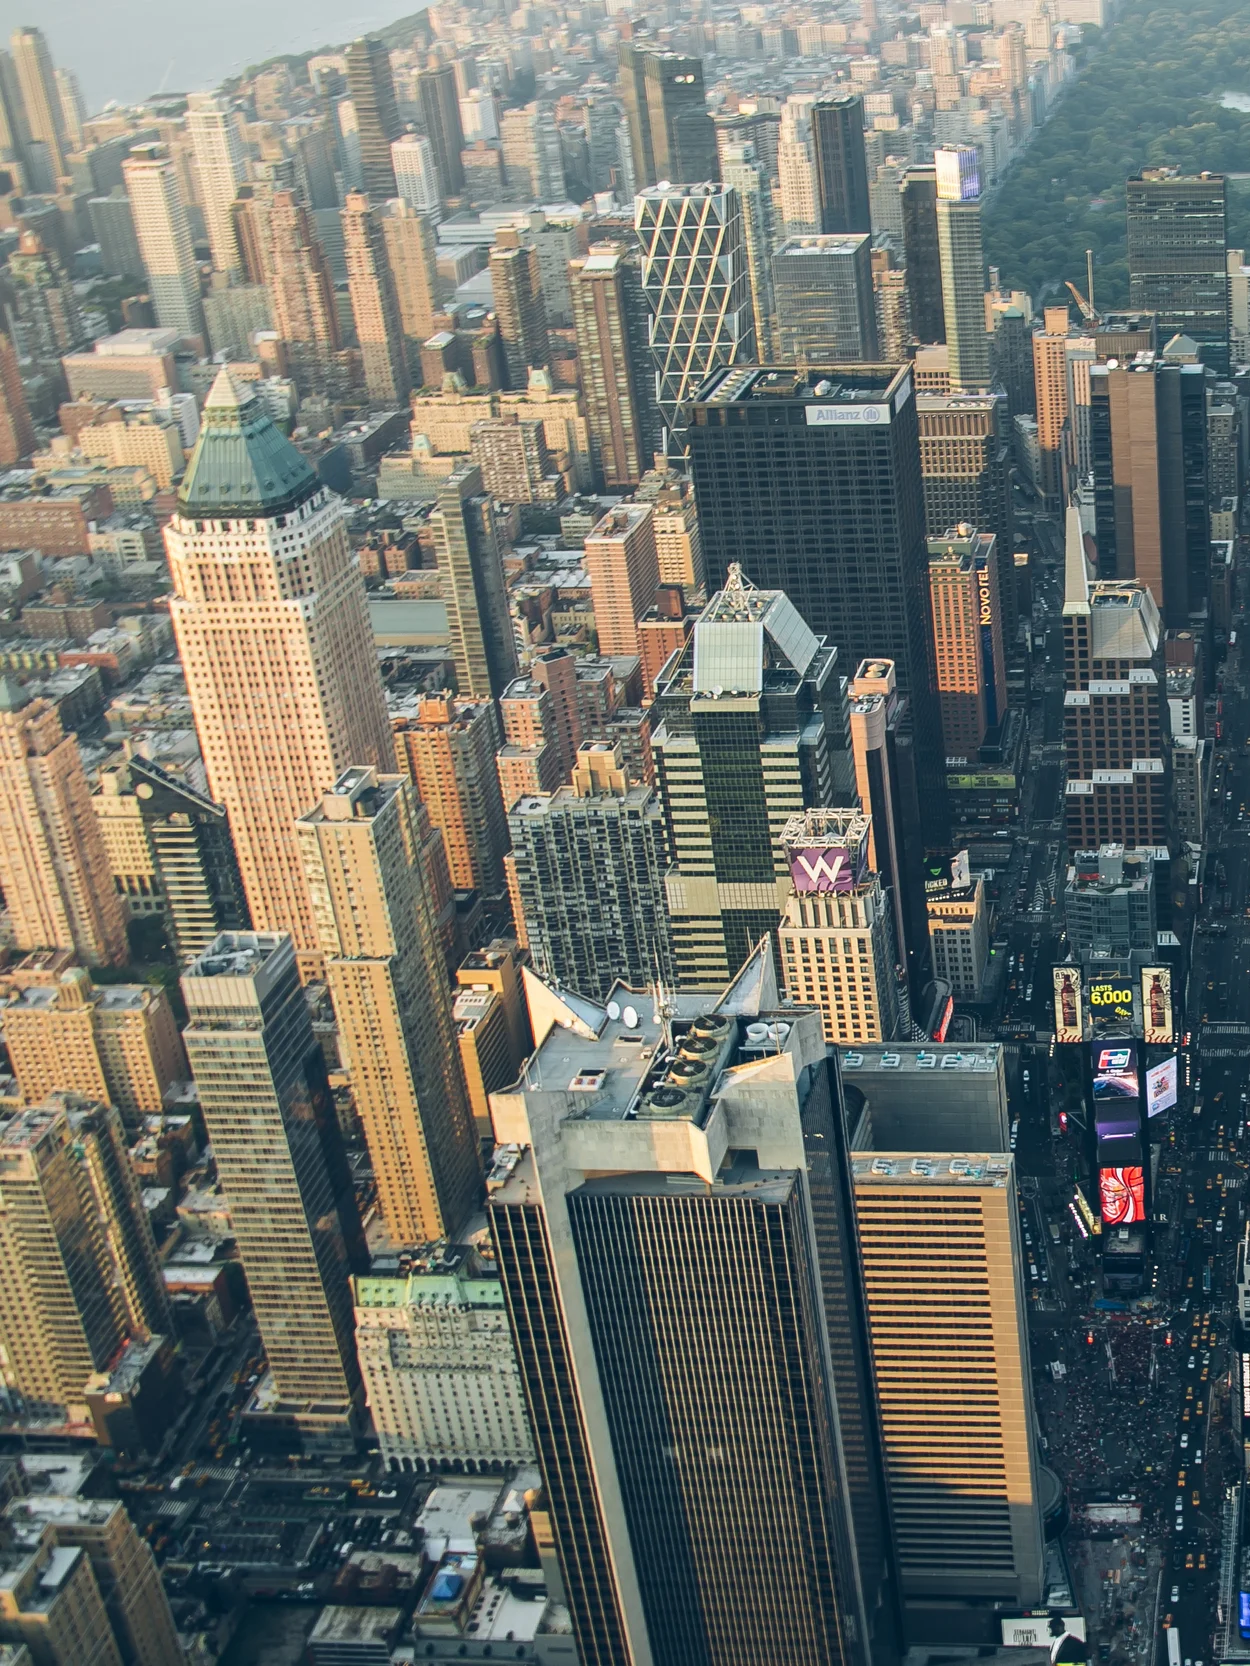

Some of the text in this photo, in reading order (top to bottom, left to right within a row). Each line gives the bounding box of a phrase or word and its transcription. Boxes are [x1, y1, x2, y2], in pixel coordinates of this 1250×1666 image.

[816, 409, 861, 421] Allianz
[976, 565, 992, 625] NOVOTEL
[797, 855, 844, 884] W
[1091, 990, 1132, 1006] 6,000
